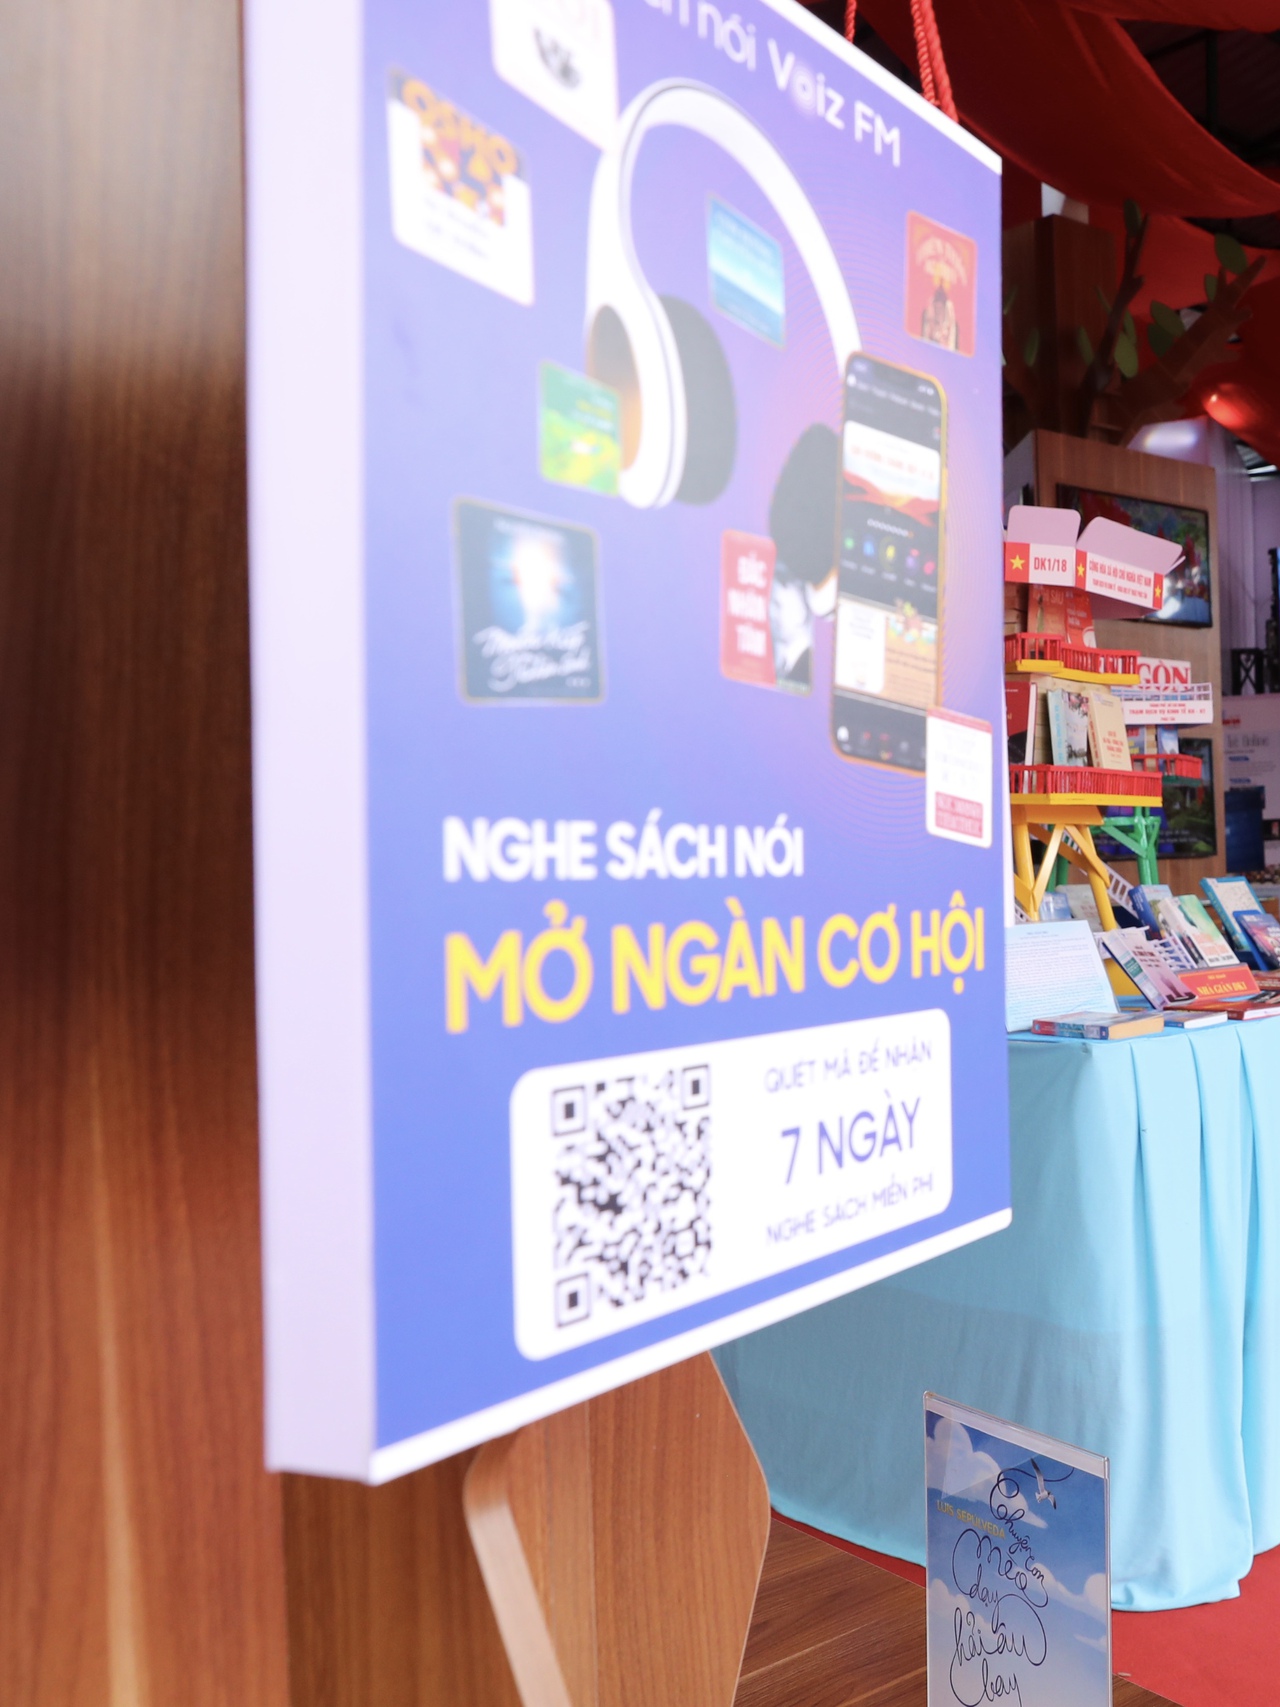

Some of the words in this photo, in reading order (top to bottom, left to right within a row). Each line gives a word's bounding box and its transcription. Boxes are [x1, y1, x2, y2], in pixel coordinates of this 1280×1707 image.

[767, 38, 845, 130] Voiz
[854, 99, 900, 167] FM
[1033, 557, 1067, 572] DK1/18
[442, 815, 598, 881] NGHE
[605, 807, 728, 880] SÁCH
[734, 813, 804, 876] NÓI
[445, 900, 593, 1033] MỞ
[611, 897, 805, 1013] NGÀN
[817, 904, 898, 987] CƠ
[910, 890, 985, 994] HỘI
[1197, 983, 1215, 995] NHÀ
[1214, 981, 1233, 993] GIÀN
[781, 1126, 801, 1184] 7
[818, 1088, 921, 1175] NGÀY
[766, 1209, 816, 1245] NGHE
[936, 1500, 954, 1517] LUIS
[956, 1508, 1005, 1540] SEPÚLVEDA
